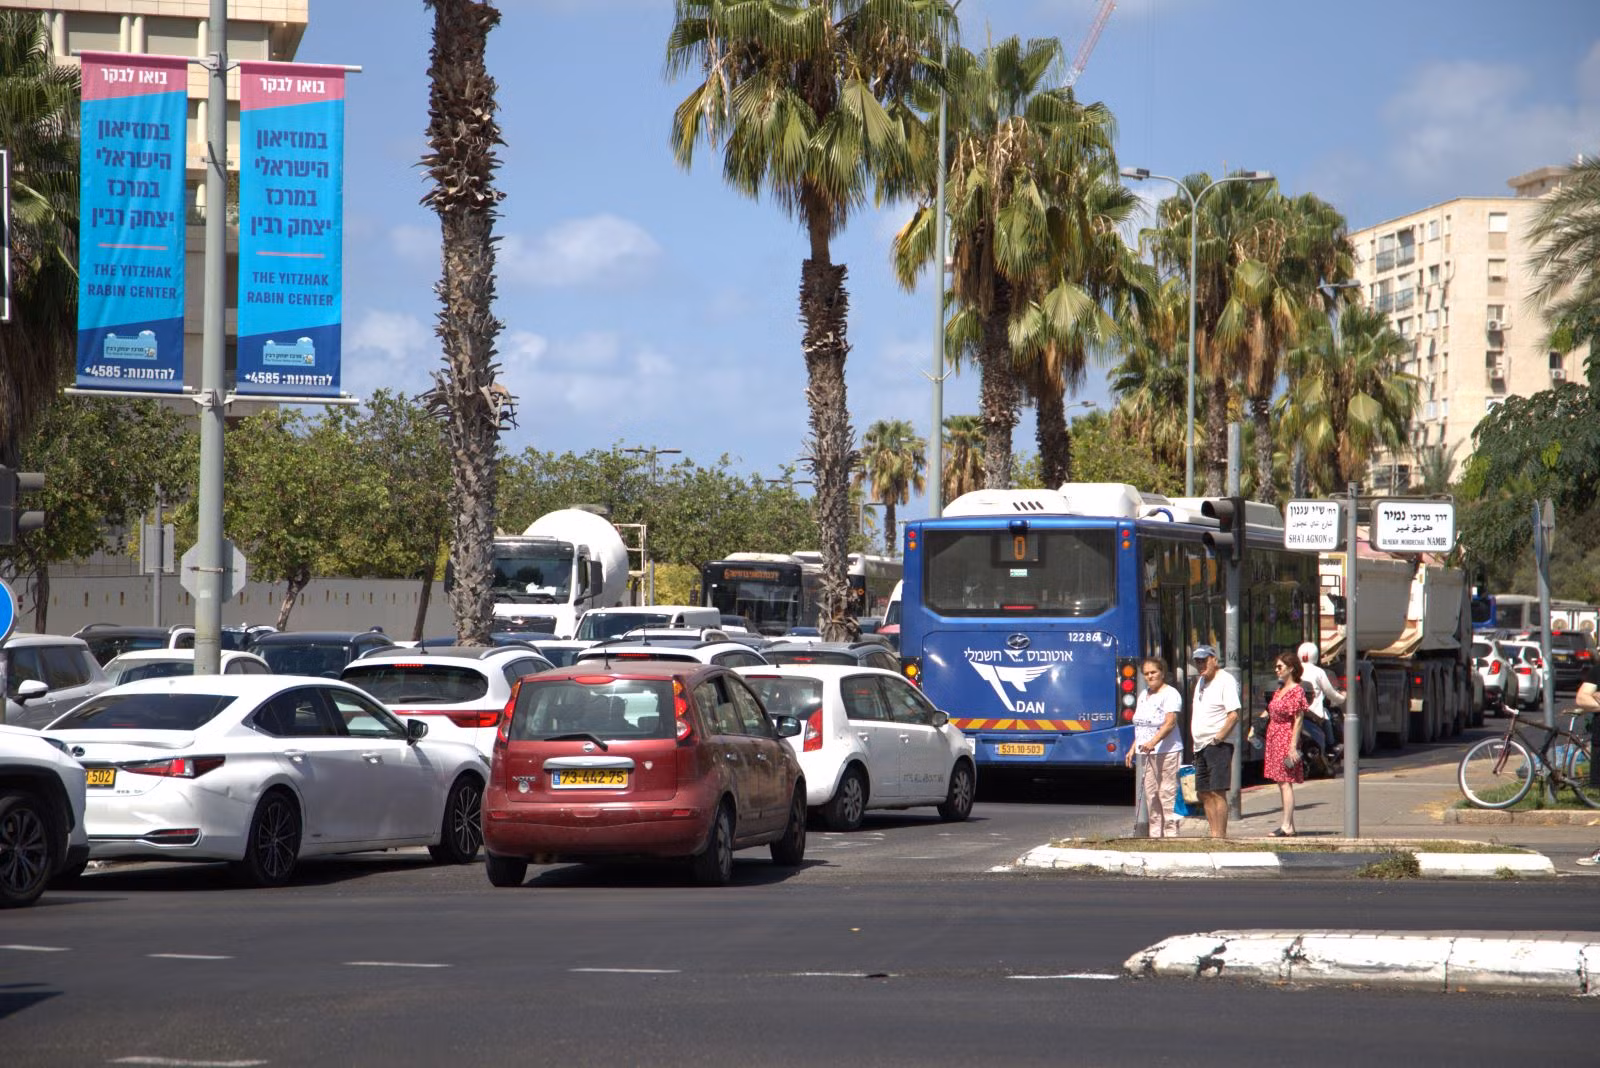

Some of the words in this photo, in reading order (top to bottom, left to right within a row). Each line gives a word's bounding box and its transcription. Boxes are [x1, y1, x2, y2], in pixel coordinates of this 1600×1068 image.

[101, 68, 135, 85] לבקר
[138, 72, 168, 85] בואו
[260, 76, 293, 94] לבקר
[296, 79, 326, 94] בואו
[98, 120, 171, 141] במוזיאון
[256, 129, 329, 150] במוזיאון
[96, 147, 172, 171] הישראלי
[254, 156, 329, 179] הישראלי
[107, 178, 160, 198] במרכז
[265, 187, 318, 207] במרכז
[91, 207, 125, 228] רבין
[130, 210, 175, 230] יצחק
[251, 216, 283, 236] רבין
[288, 218, 332, 238] יצחק
[94, 263, 118, 276] THE
[120, 264, 172, 279] YITZHAK
[252, 271, 276, 285] THE
[278, 272, 329, 287] YITZHAK
[88, 284, 126, 297] RABIN
[130, 286, 177, 300] CENTER
[247, 291, 285, 305] RABIN
[288, 293, 334, 307] CENTER
[123, 366, 175, 381] להזמנות:
[282, 373, 333, 387] להזמנות:
[1384, 511, 1405, 520] נמיר
[1435, 514, 1447, 522] דרך
[1306, 534, 1327, 544] AGNON
[1427, 536, 1447, 546] NAMIR
[964, 647, 1001, 661] חשמלי
[1027, 650, 1073, 662] אוטובוס
[1016, 701, 1045, 714] DAN
[1078, 712, 1114, 721] HIGER
